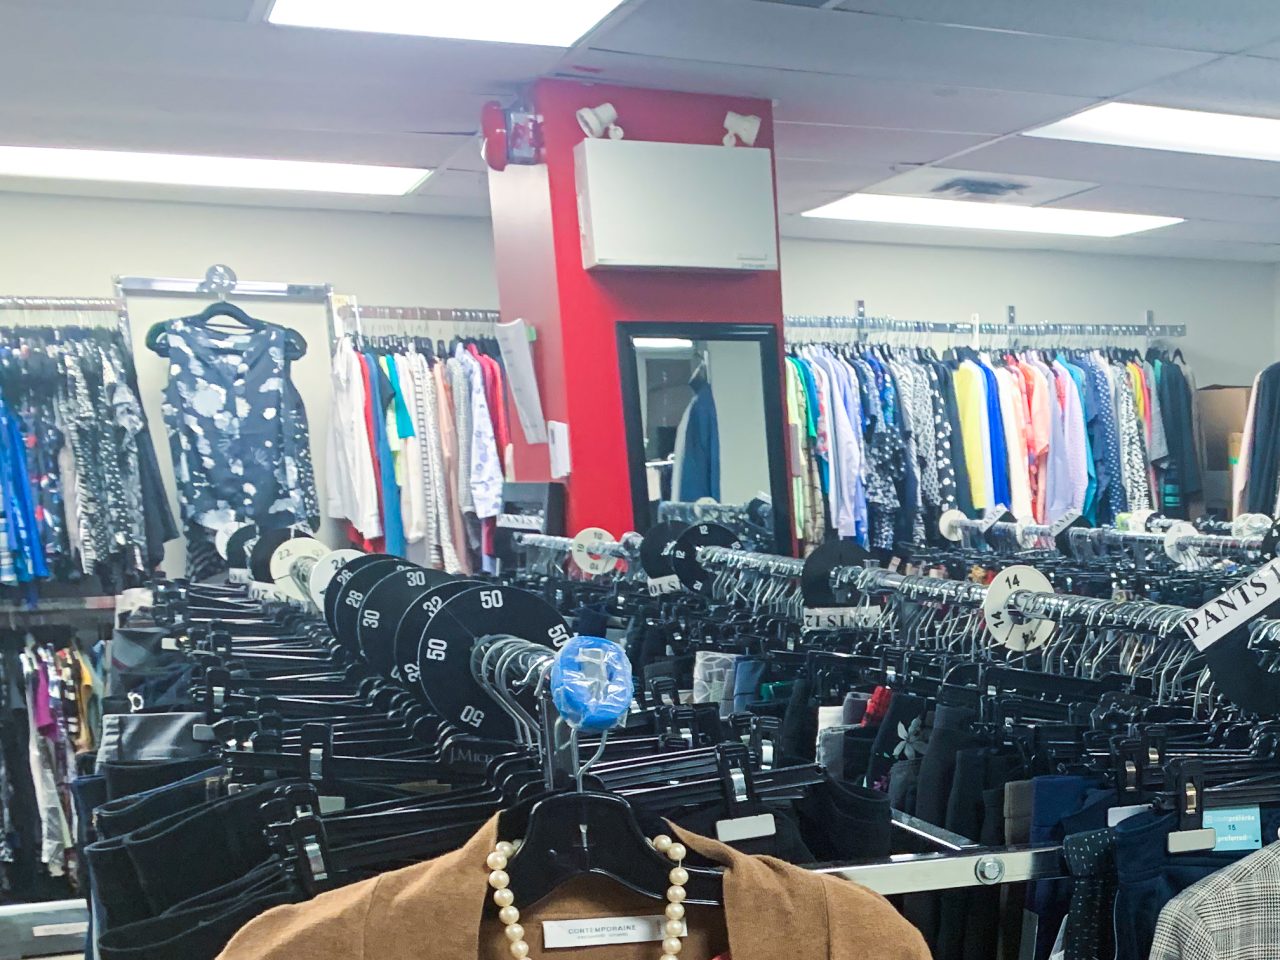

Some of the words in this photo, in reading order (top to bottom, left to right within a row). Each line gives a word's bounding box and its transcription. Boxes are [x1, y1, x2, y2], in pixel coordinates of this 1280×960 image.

[593, 531, 604, 540] 10
[576, 544, 585, 553] 10
[676, 550, 686, 559] 12
[406, 571, 426, 587] 30
[1005, 573, 1020, 589] 14
[345, 590, 363, 608] 28
[422, 595, 442, 618] 32
[480, 589, 504, 609] 50
[1184, 573, 1268, 639] PANTS
[362, 609, 380, 629] 30
[991, 610, 1005, 629] 14
[547, 623, 570, 648] 50
[426, 637, 448, 662] 50
[460, 705, 485, 728] 50
[568, 924, 637, 935] CONTEMPORAINE
